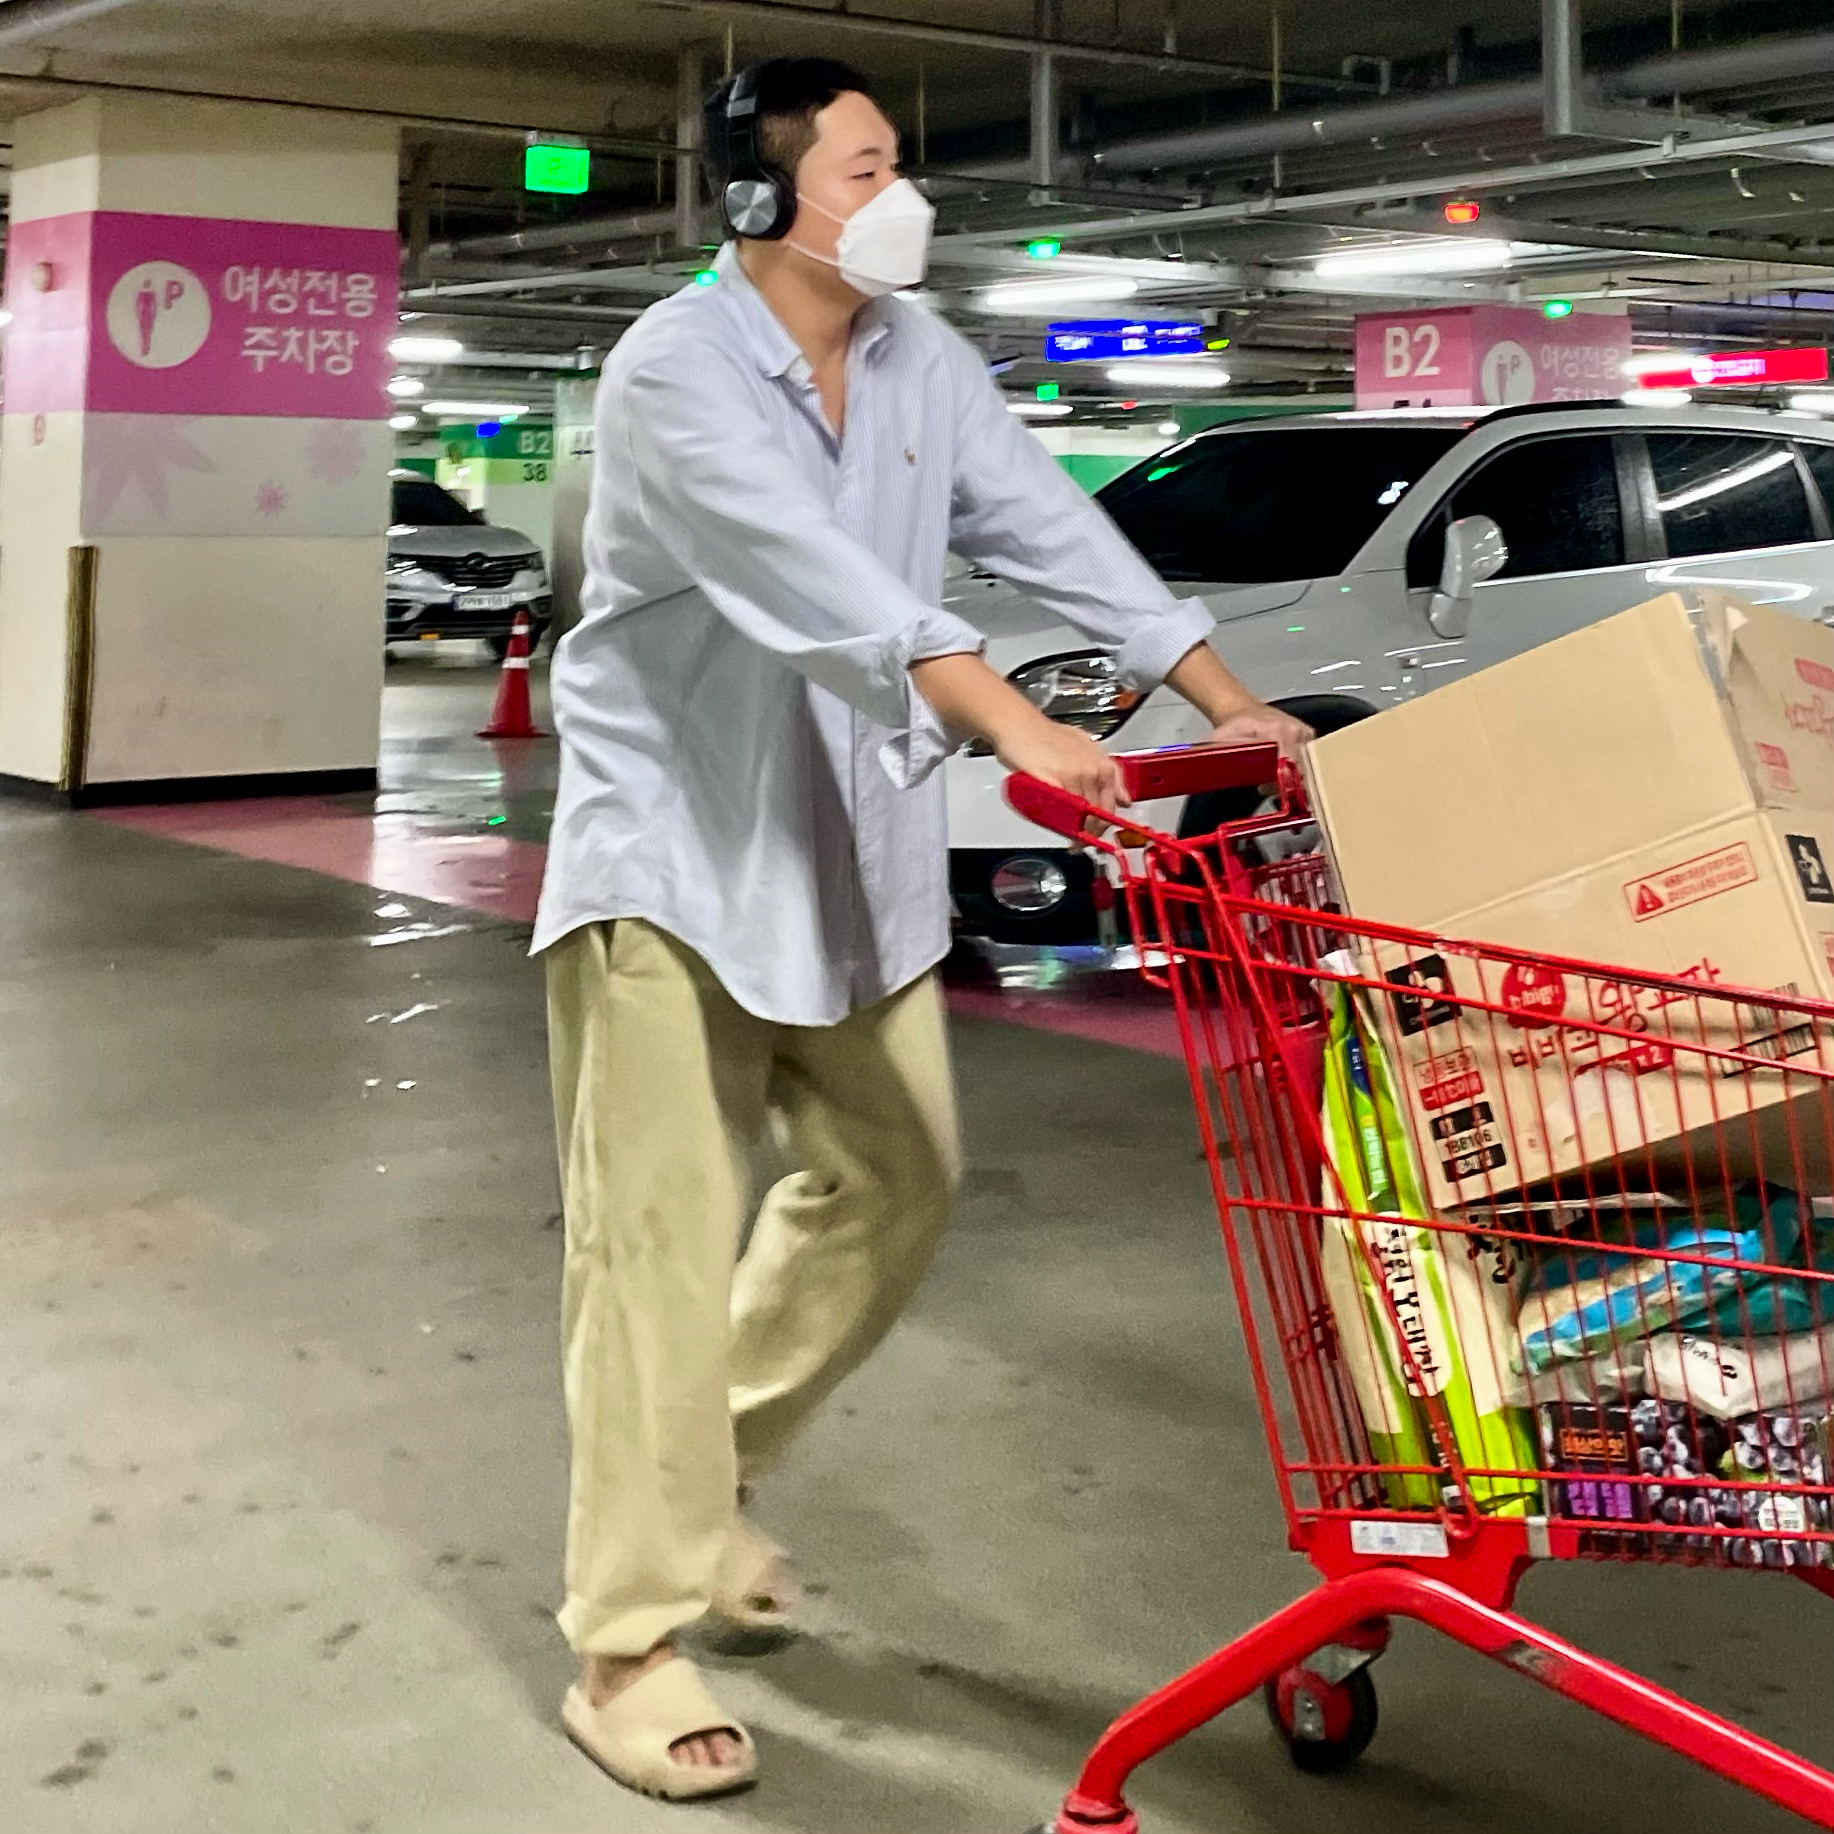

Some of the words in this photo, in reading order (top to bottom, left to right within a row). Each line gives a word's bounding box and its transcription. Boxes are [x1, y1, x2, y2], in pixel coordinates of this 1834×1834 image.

[223, 264, 379, 318] 여성전용
[240, 325, 360, 376] 주차장
[1384, 324, 1441, 379] B2
[519, 430, 551, 455] B2
[523, 462, 548, 482] 38
